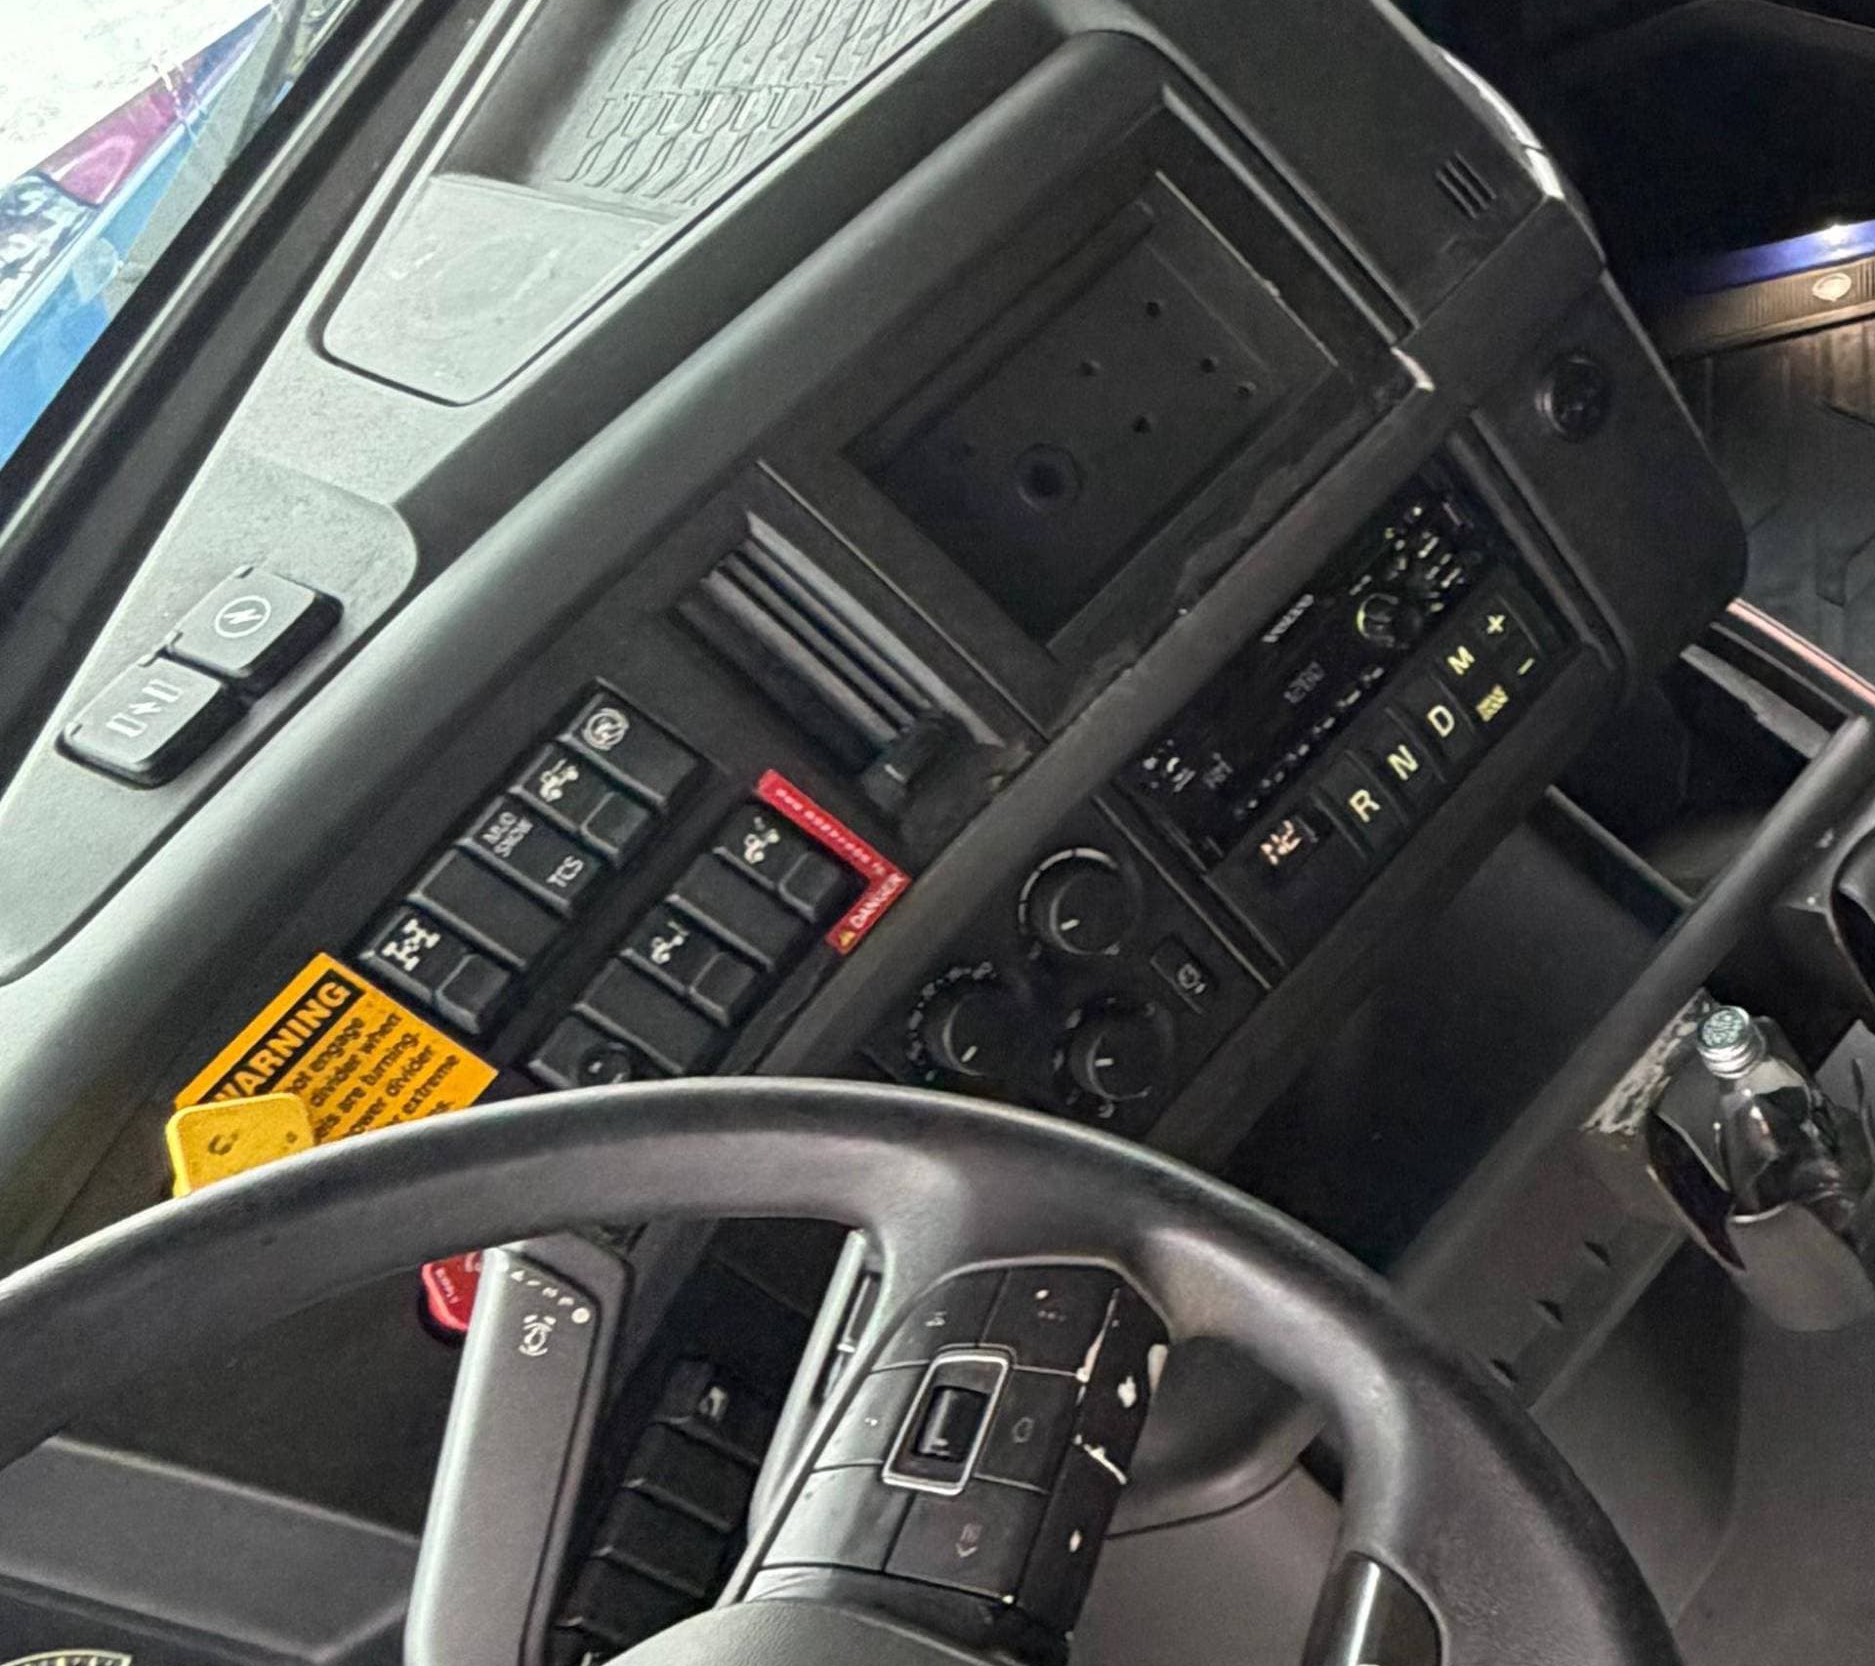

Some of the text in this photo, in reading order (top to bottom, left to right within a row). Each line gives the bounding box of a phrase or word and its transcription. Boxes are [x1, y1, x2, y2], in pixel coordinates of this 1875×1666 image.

[1427, 705, 1455, 737] D
[1387, 744, 1418, 780] N
[1350, 789, 1380, 823] R
[546, 855, 584, 888] TCS
[305, 1010, 403, 1109] divider when
[307, 1015, 369, 1077] engage
[381, 1043, 437, 1100] divider
[396, 1051, 462, 1117] extreme
[335, 1083, 366, 1115] are
